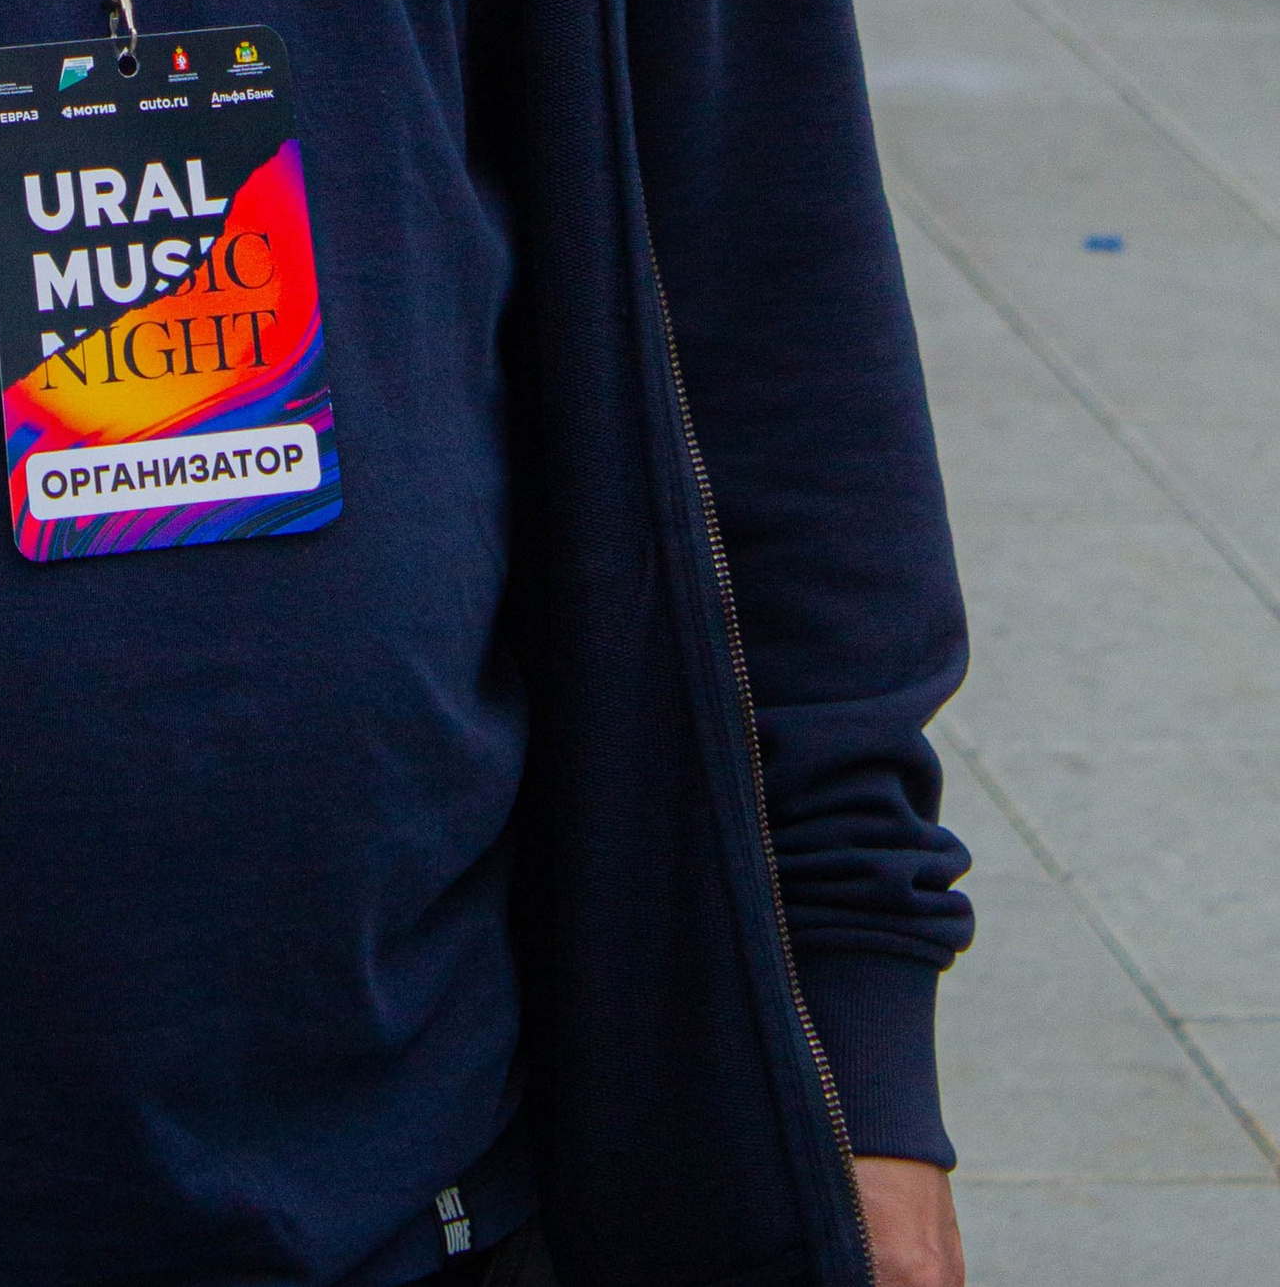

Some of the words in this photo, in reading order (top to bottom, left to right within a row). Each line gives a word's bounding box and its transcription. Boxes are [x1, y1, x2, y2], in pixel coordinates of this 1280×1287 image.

[0, 109, 40, 124] ЕВРАЗ
[139, 96, 189, 111] auto.ru
[23, 159, 230, 232] URAL
[32, 232, 275, 312] MUSIC
[39, 309, 279, 391] NIGHT
[41, 443, 306, 500] ОРГАНИЗАТОР
